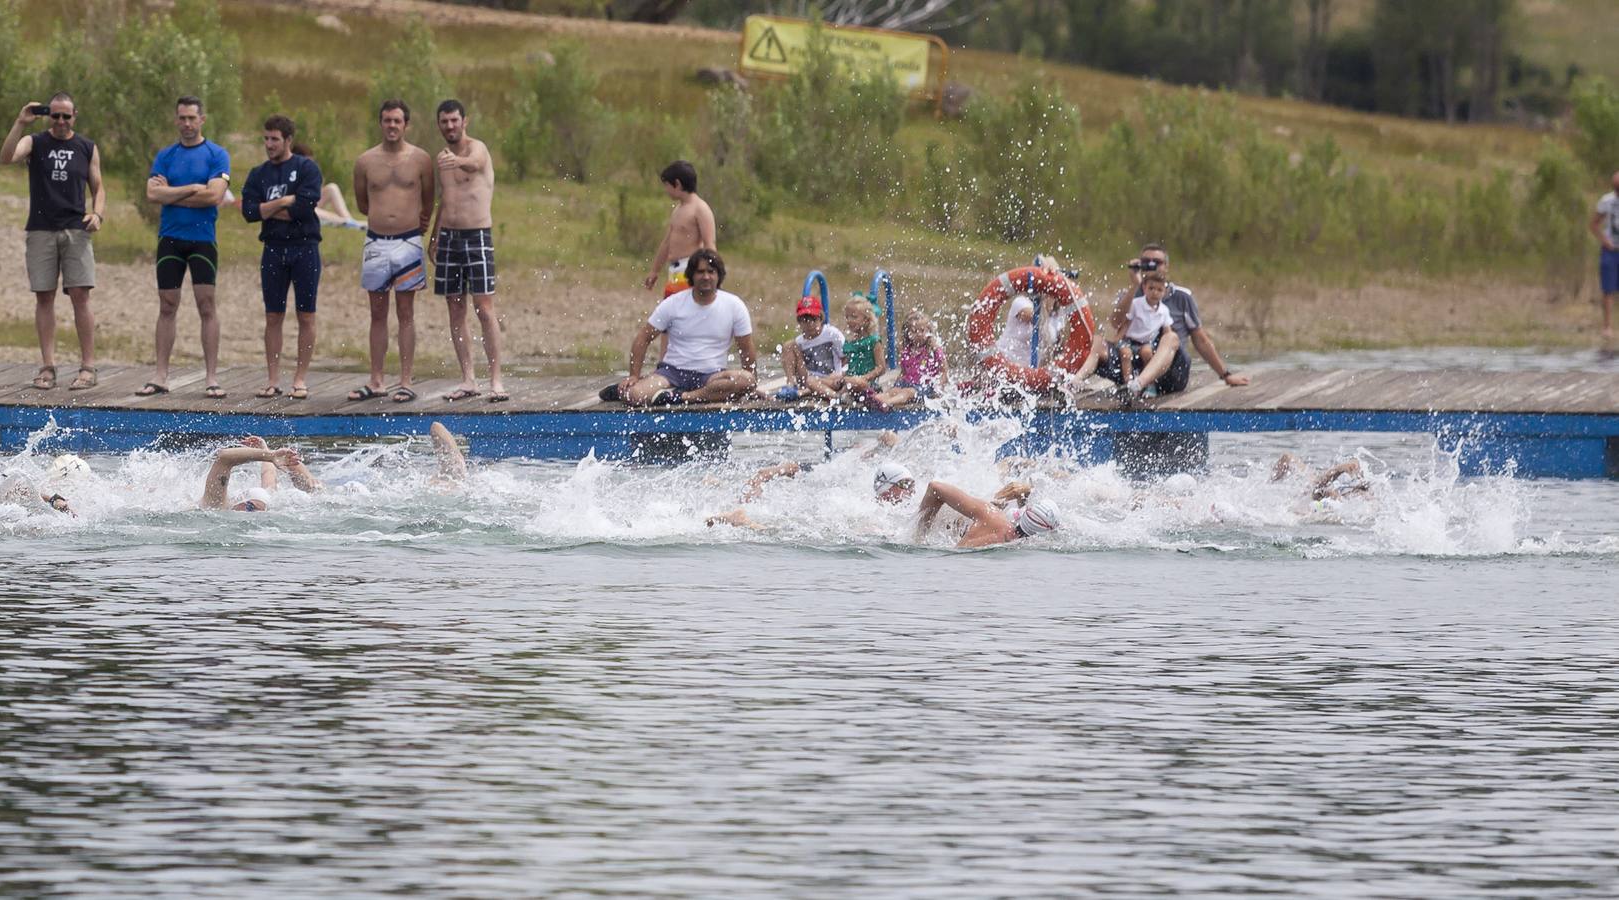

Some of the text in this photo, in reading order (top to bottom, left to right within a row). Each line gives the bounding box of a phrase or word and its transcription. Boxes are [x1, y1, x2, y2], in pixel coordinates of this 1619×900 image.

[48, 149, 74, 160] ACT
[54, 160, 67, 170] IV
[51, 170, 68, 181] ES
